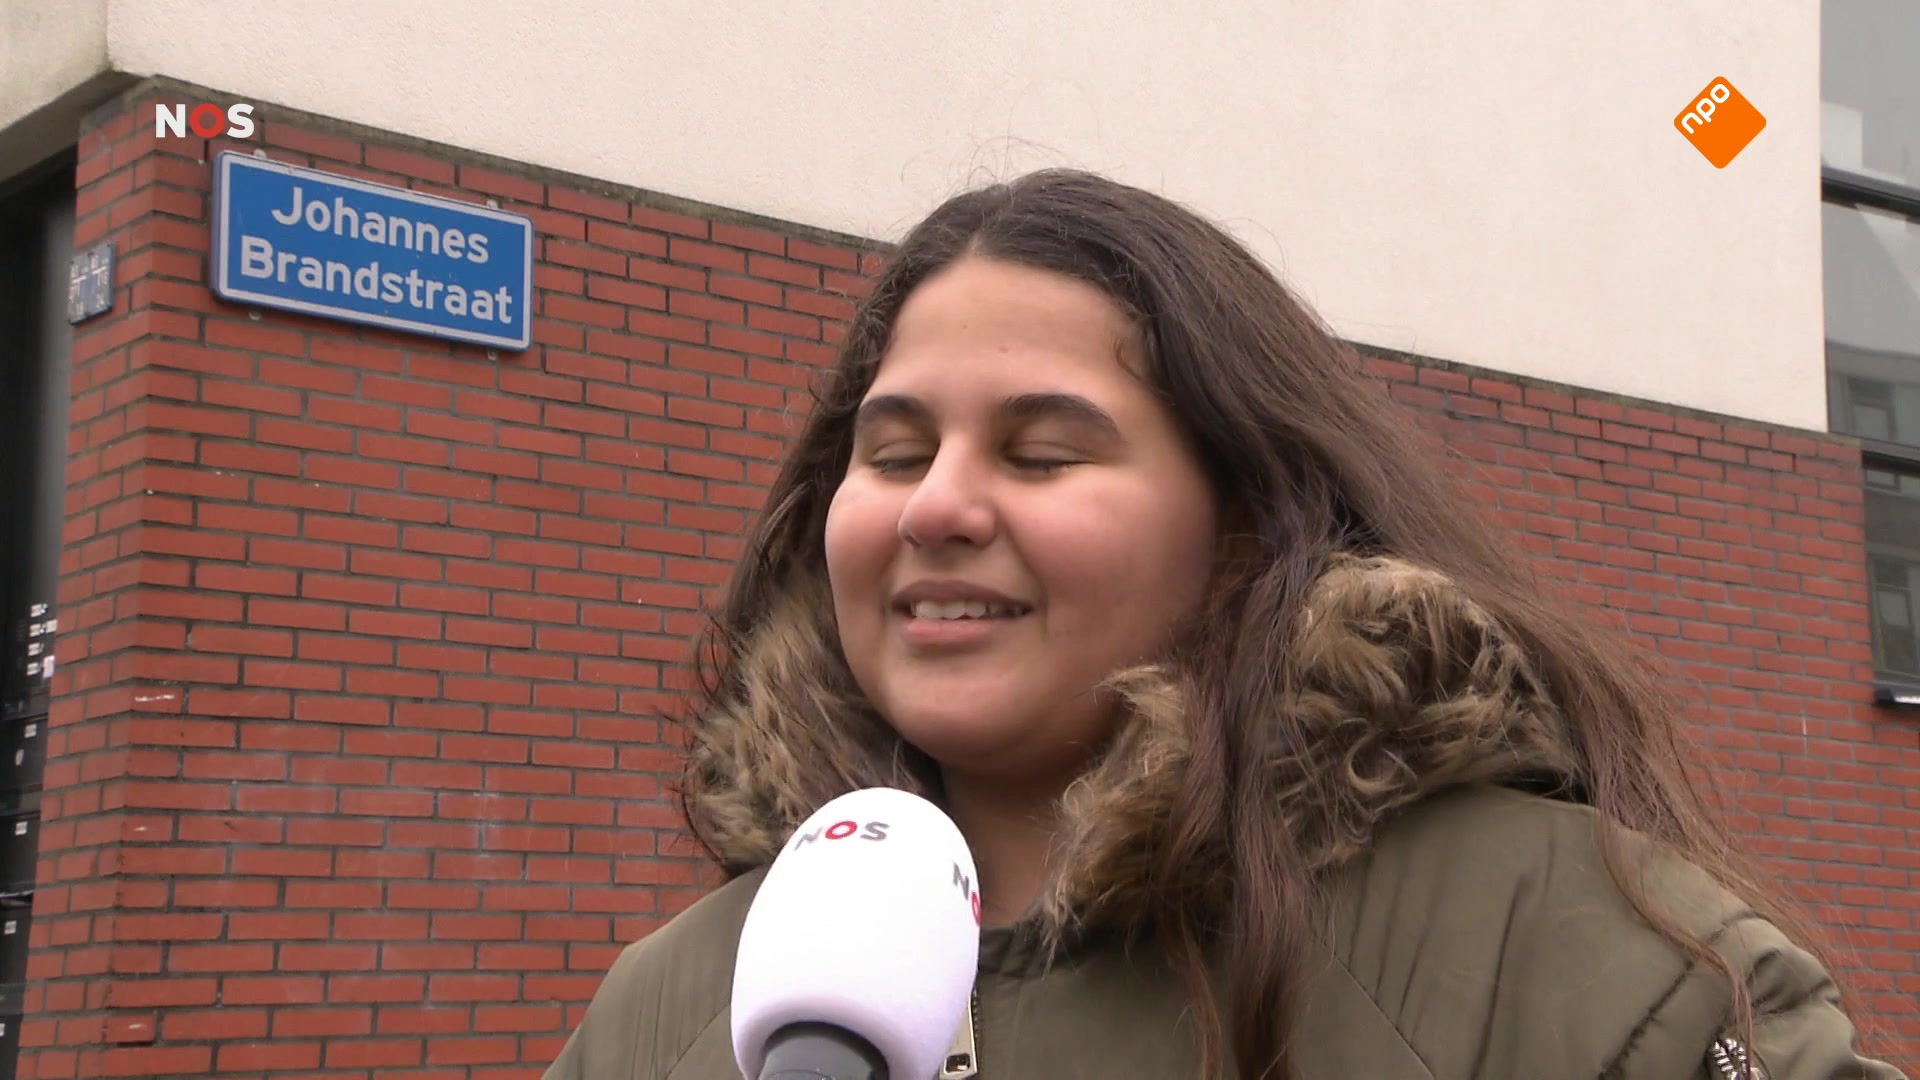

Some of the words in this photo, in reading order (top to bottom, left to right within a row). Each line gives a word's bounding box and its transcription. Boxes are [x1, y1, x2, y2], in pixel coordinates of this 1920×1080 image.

[272, 187, 489, 264] Johannes
[240, 235, 512, 324] Brandstraat
[794, 820, 889, 851] NOS
